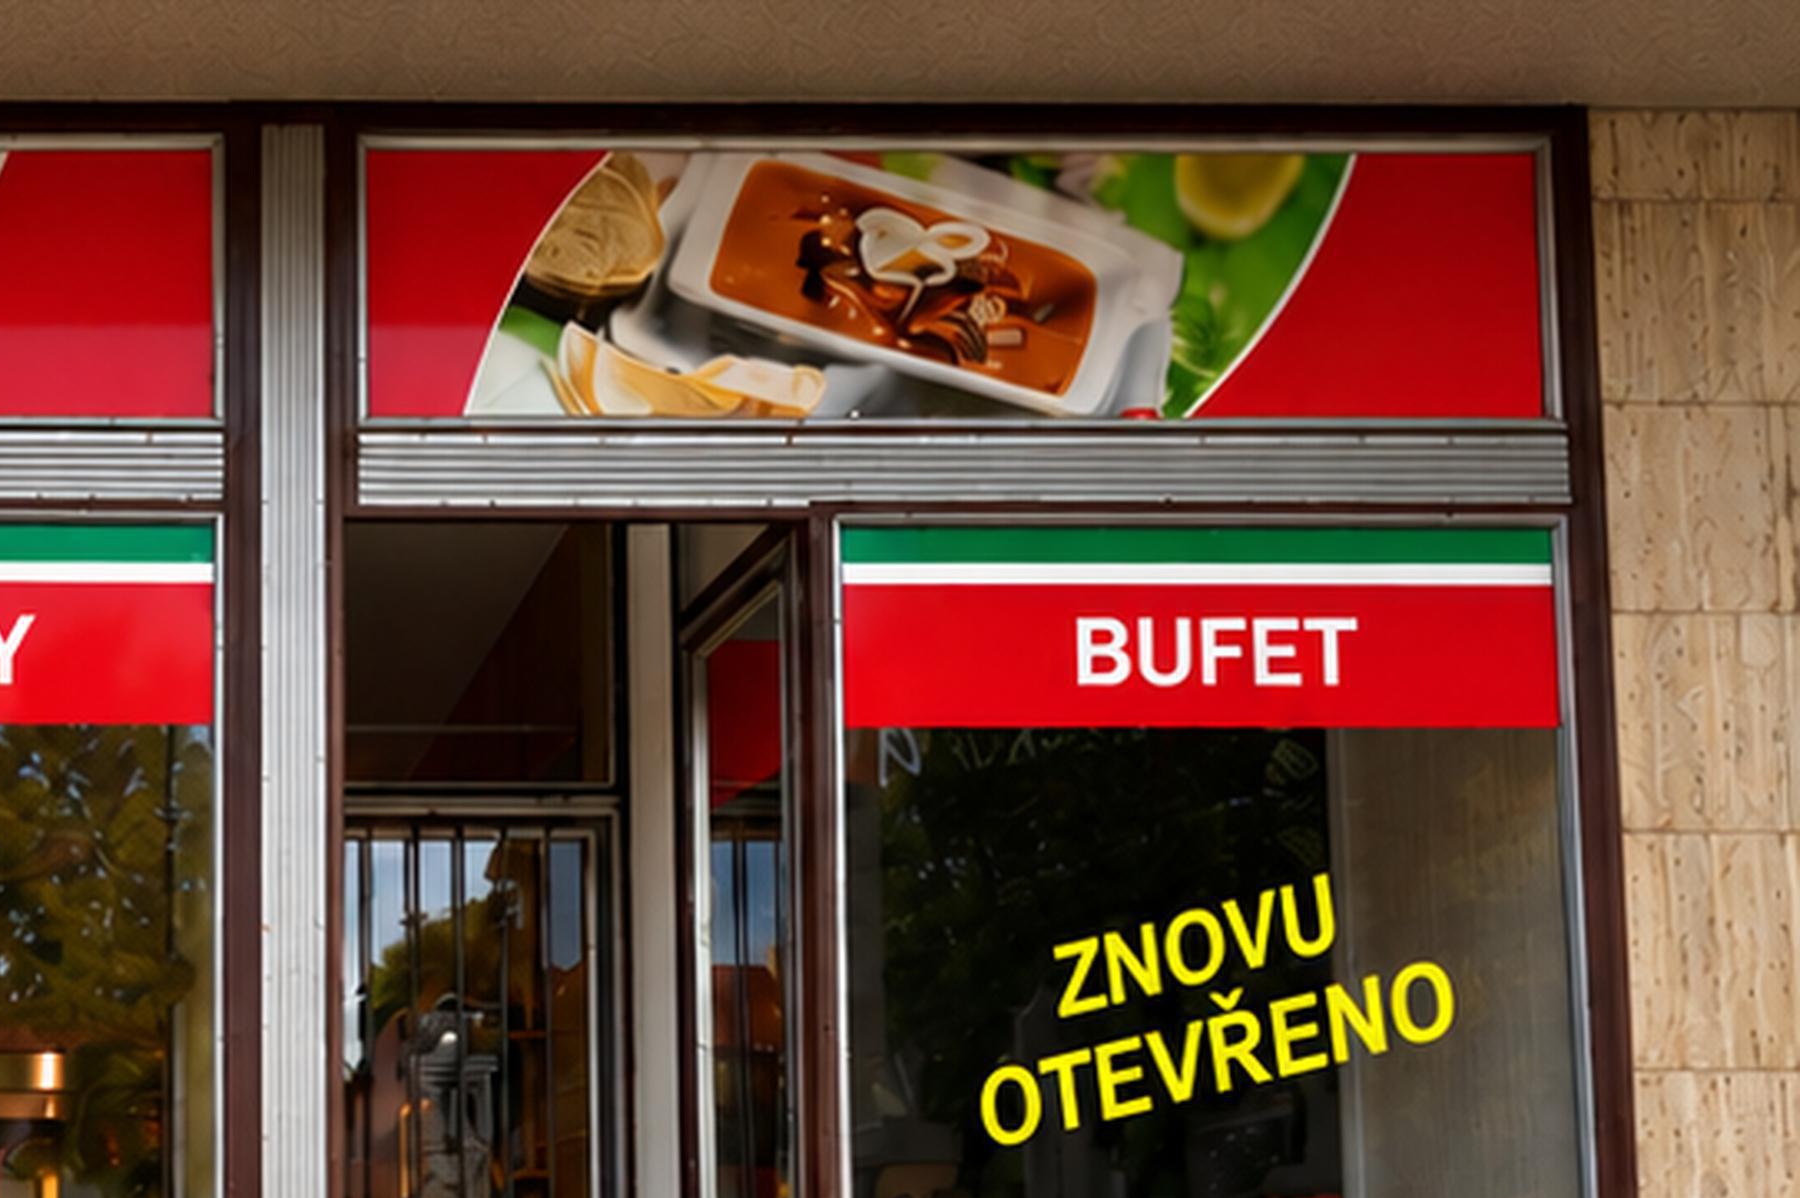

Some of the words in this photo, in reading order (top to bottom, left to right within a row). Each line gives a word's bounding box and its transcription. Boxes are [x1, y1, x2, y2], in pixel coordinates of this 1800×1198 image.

[1076, 617, 1358, 687] BUFET
[1053, 873, 1336, 1018] ZNOVU
[980, 962, 1455, 1146] OTEVŘENO
